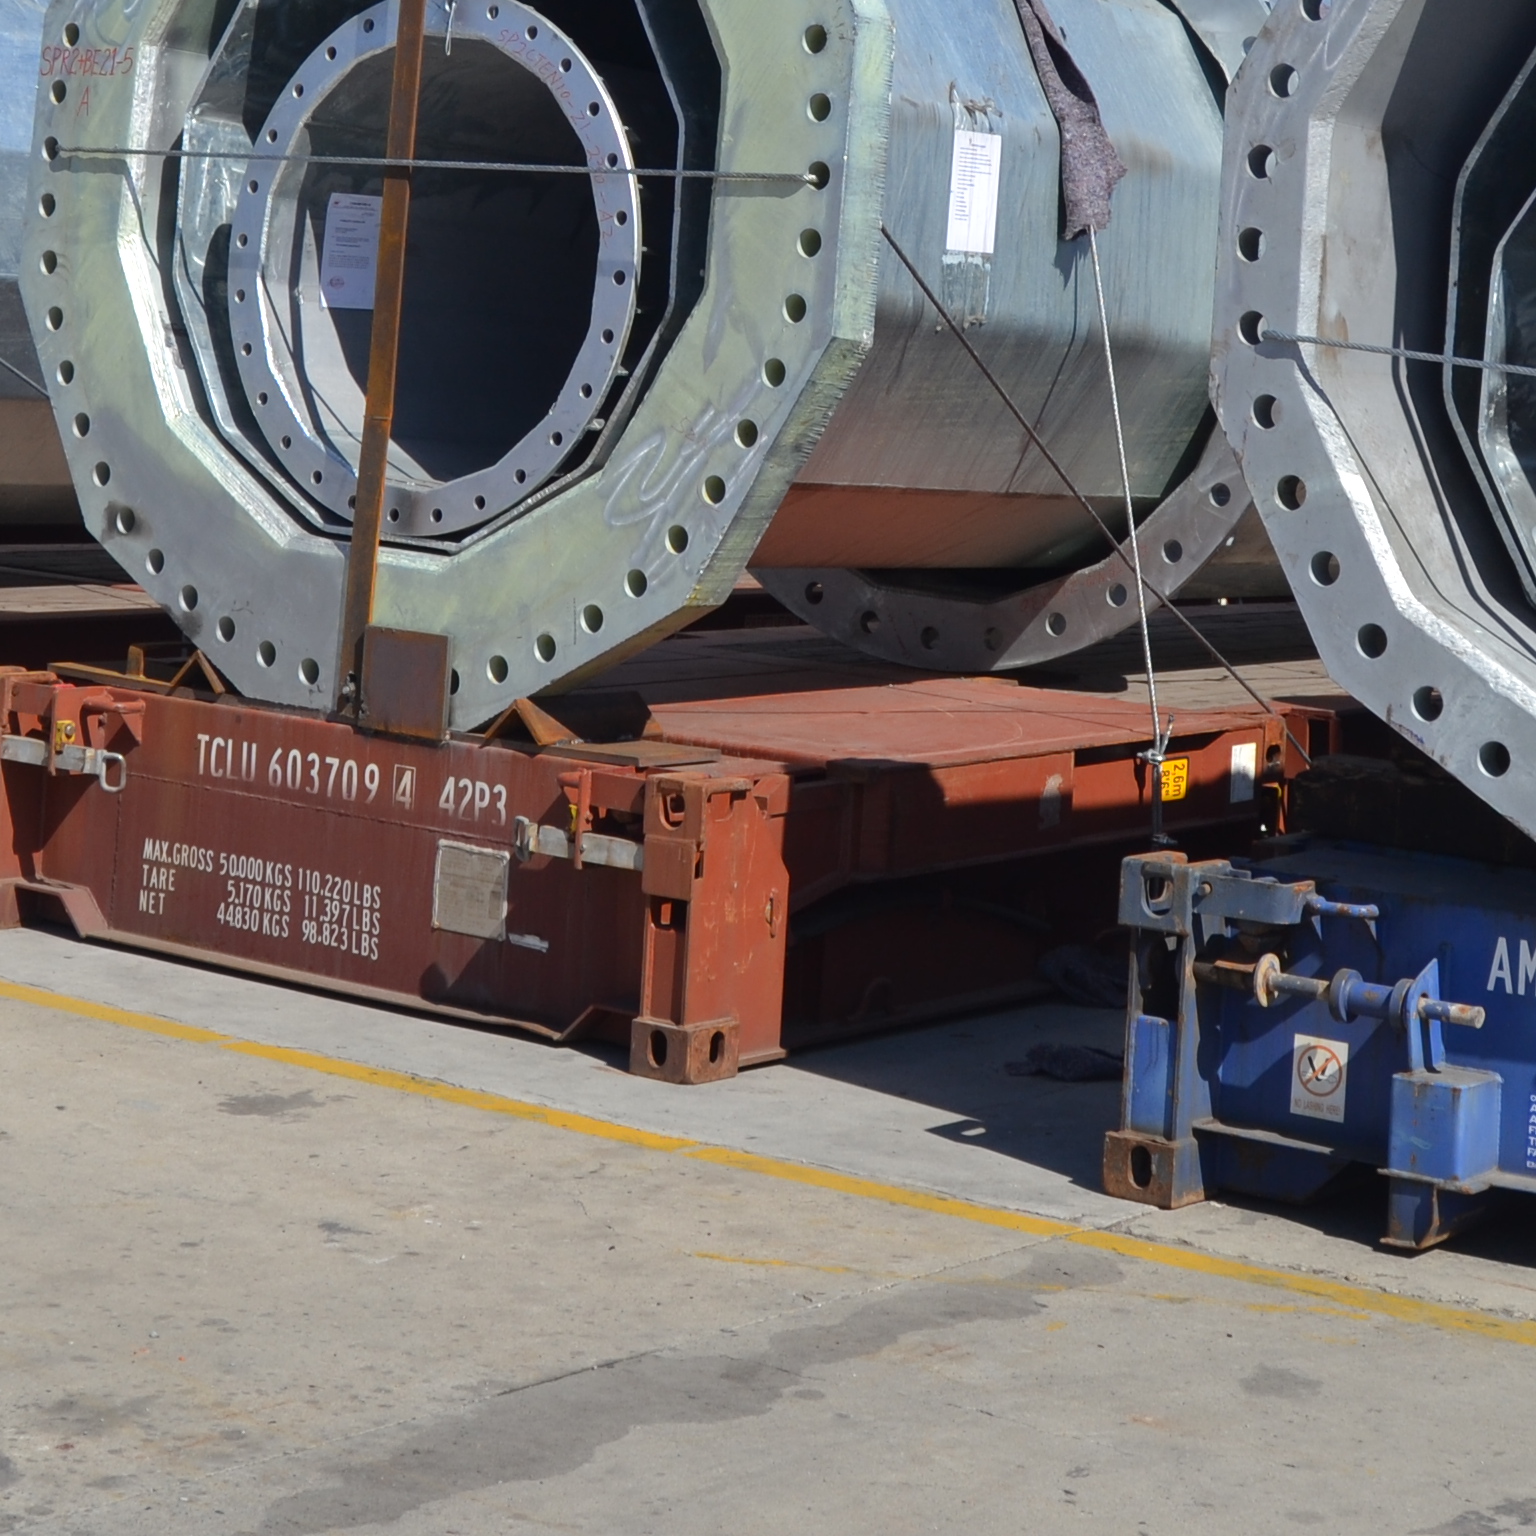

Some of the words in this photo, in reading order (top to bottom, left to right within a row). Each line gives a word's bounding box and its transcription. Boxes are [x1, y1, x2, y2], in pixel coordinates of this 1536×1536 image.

[76, 85, 90, 117] A
[197, 733, 257, 783] TCLU
[267, 747, 380, 805] 603709
[395, 769, 413, 810] 4
[439, 776, 507, 826] 42P3
[142, 864, 176, 892] TARE
[264, 887, 291, 913] KGS
[353, 907, 381, 935] LBS
[265, 861, 292, 888] KGS
[298, 867, 352, 904] 110.220
[353, 881, 381, 910] LBS
[139, 889, 166, 915] NET
[263, 912, 290, 938] KGS
[302, 920, 348, 951] 98.823
[351, 932, 379, 961] LBS
